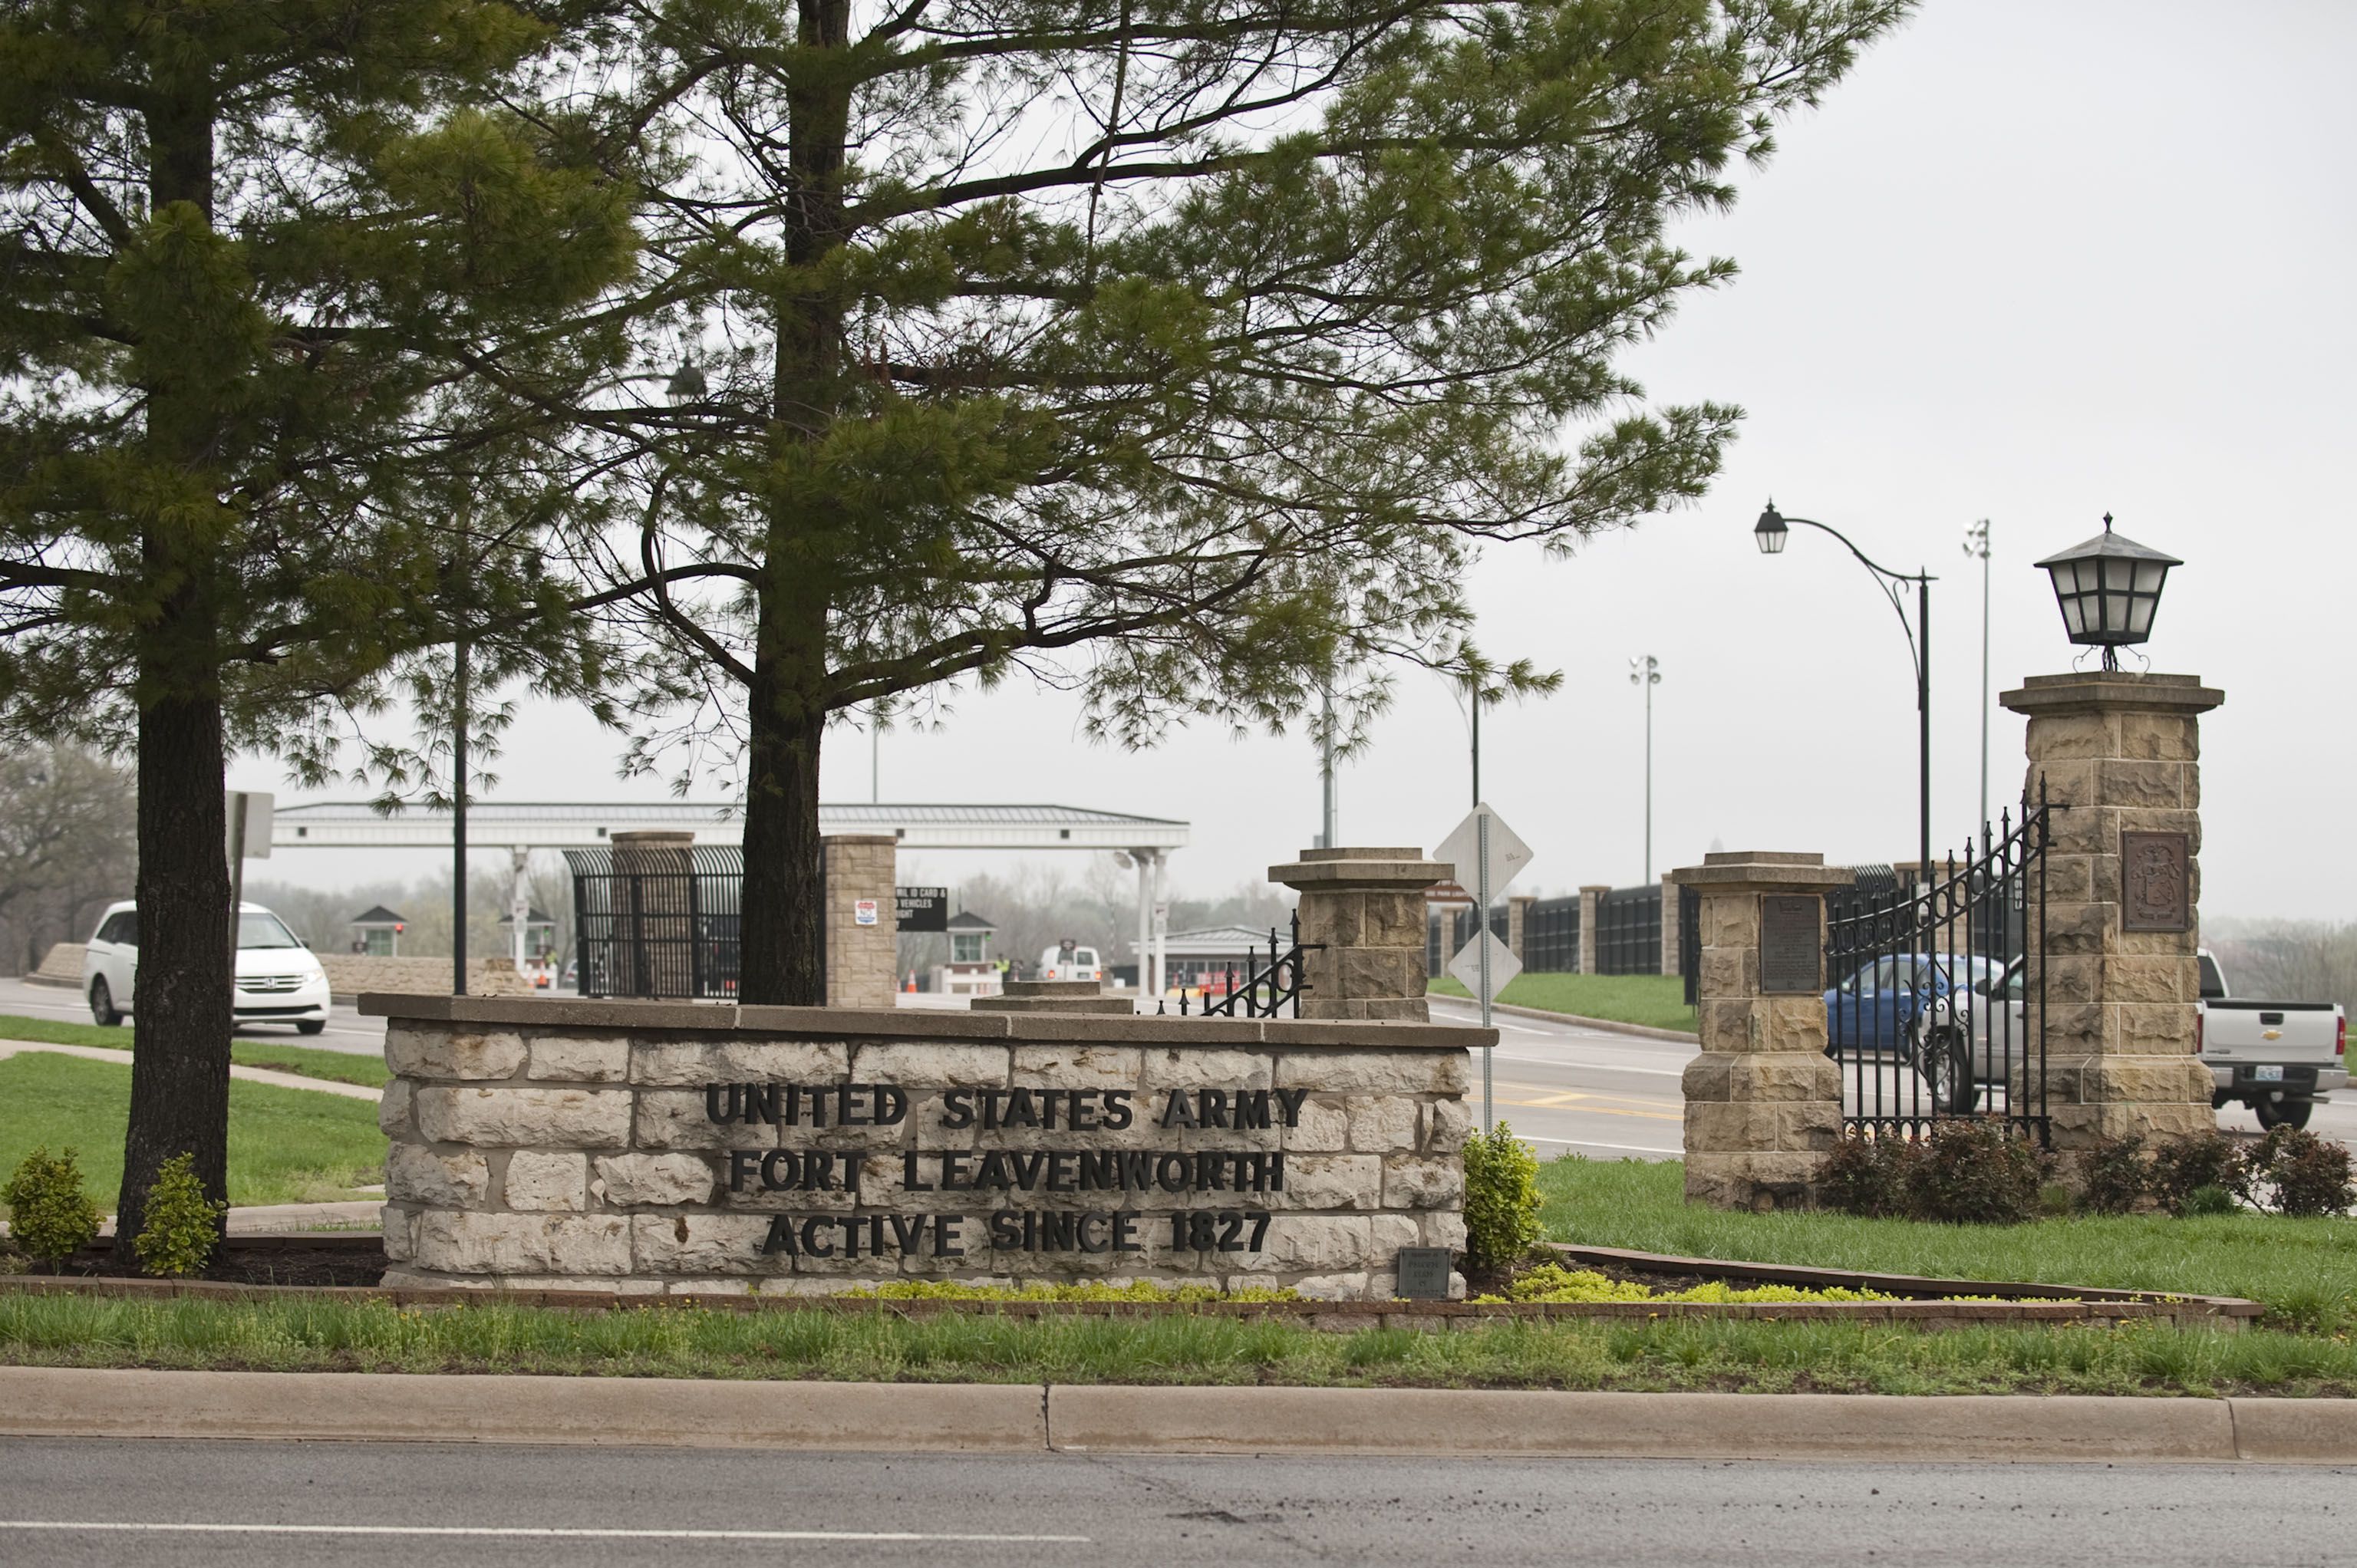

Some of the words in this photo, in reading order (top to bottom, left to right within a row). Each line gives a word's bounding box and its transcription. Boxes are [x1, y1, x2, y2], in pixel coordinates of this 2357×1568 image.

[900, 898, 932, 908] VEHICLES
[920, 888, 938, 898] CARD
[706, 1083, 908, 1128] UNITED
[942, 1087, 1132, 1131] STATES
[1162, 1088, 1307, 1129] ARMY
[731, 1149, 867, 1192] FORT
[904, 1150, 1283, 1192] LEAVENWORTH
[762, 1214, 964, 1258] ACTIVE
[991, 1211, 1141, 1253] SINCE
[1171, 1211, 1271, 1252] 1827
